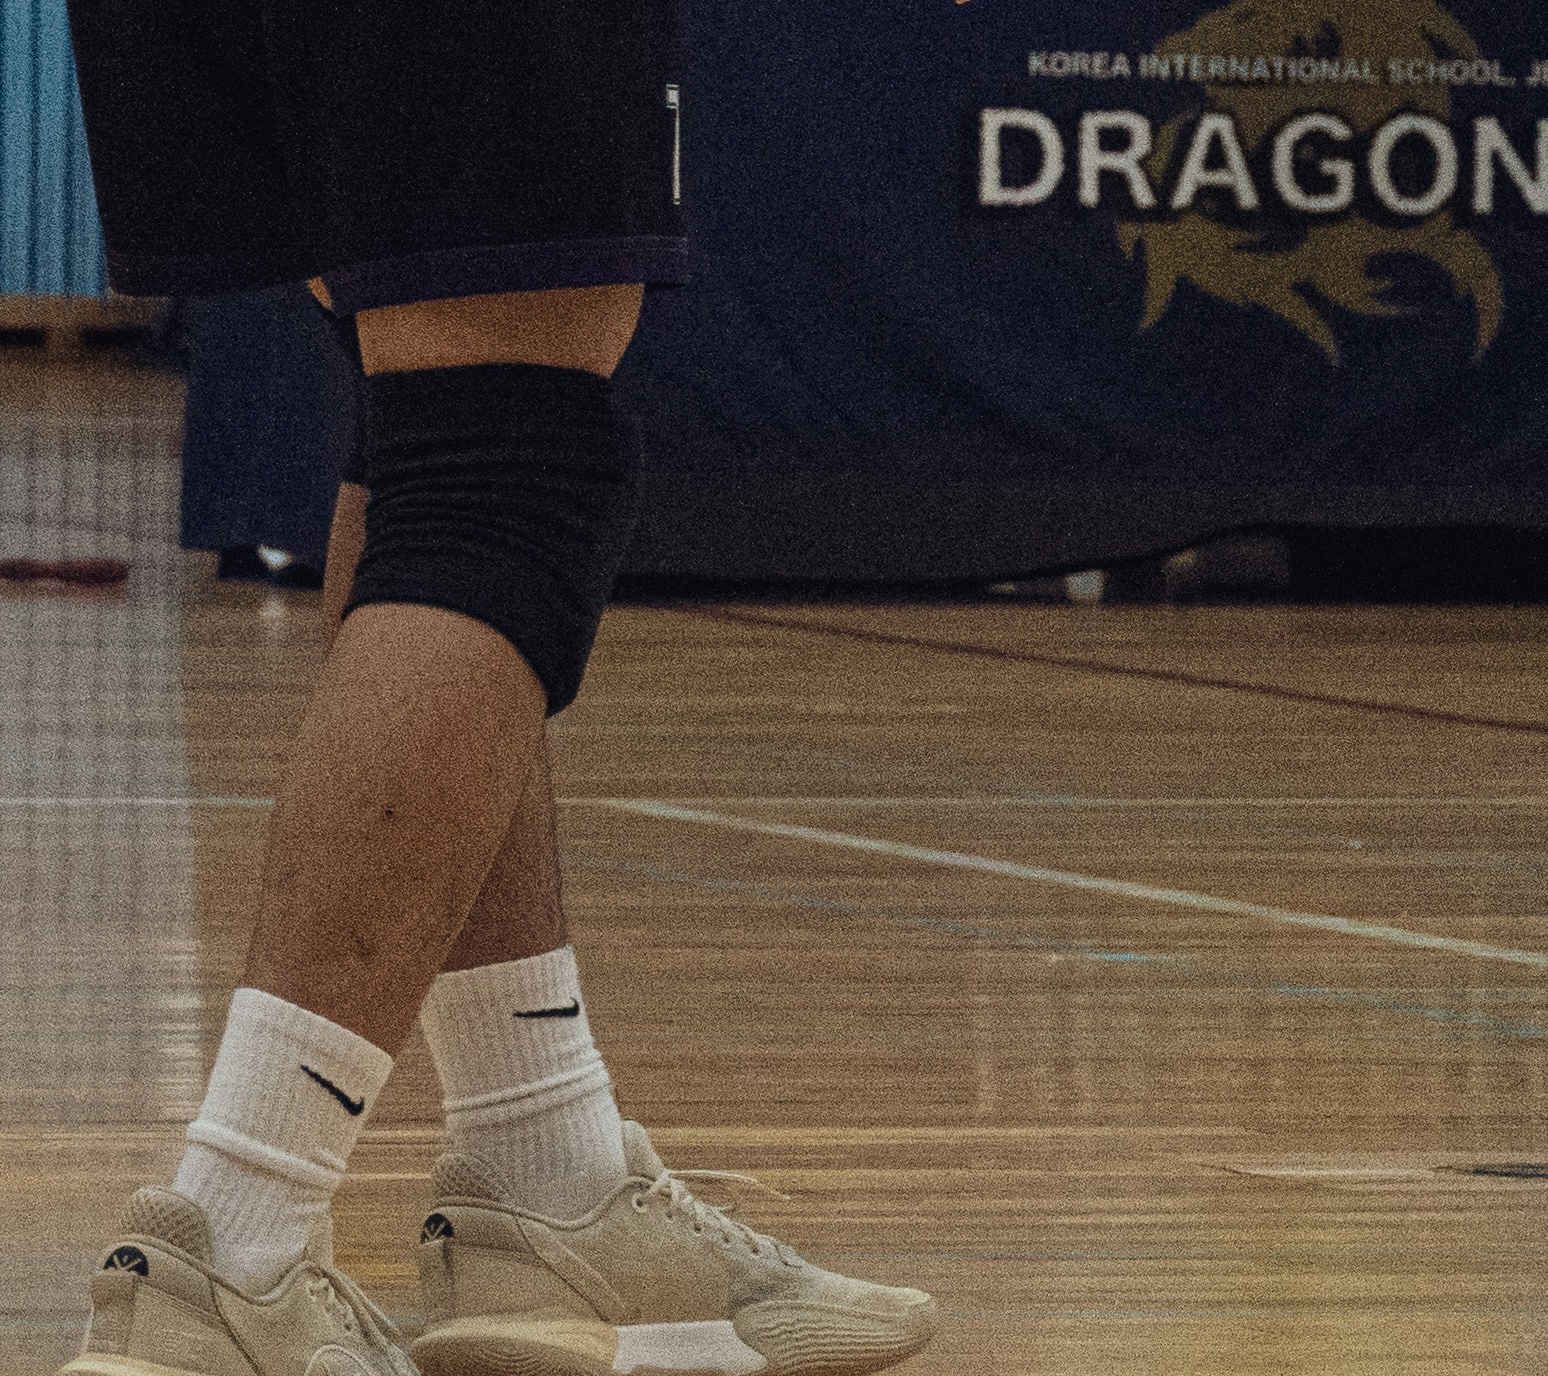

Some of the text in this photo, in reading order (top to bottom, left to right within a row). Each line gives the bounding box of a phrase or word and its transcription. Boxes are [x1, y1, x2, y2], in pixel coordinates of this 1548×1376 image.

[1027, 50, 1132, 79] KOREA
[1137, 51, 1376, 84] INTERNATIONAL
[977, 106, 1548, 216] DRAGON
